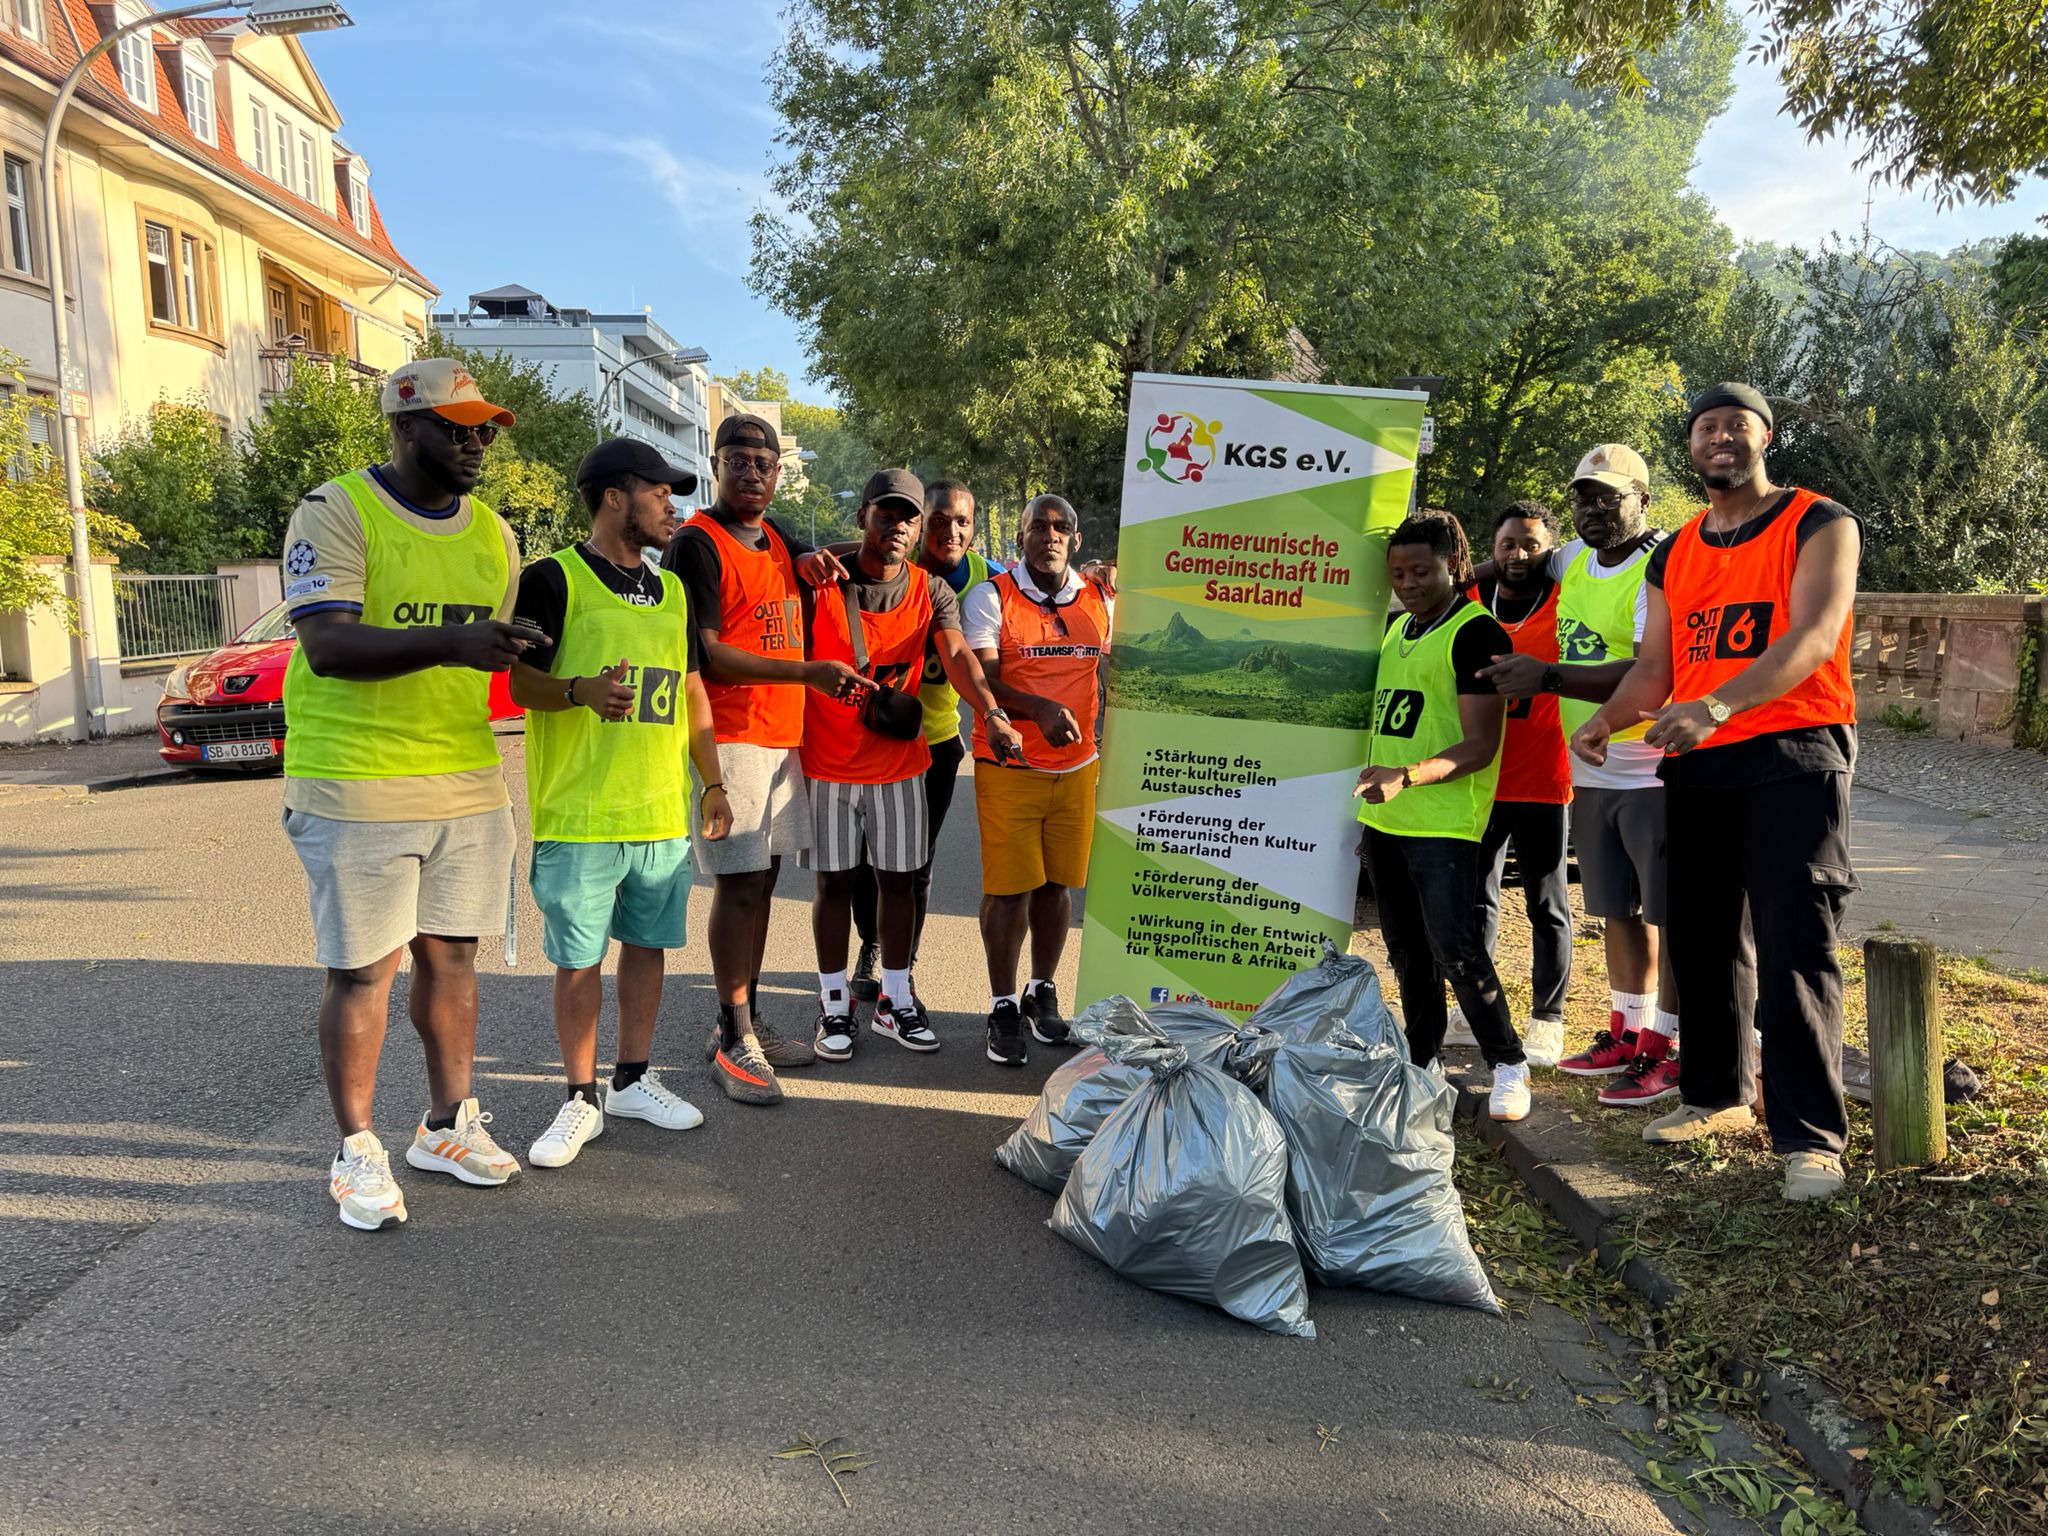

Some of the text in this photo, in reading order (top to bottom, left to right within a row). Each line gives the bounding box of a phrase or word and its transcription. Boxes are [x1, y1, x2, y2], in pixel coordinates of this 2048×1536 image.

[1224, 443, 1350, 473] KGS e.V.
[1182, 524, 1340, 558] Kamerunische
[1165, 550, 1350, 586] Gemeinschaft im
[312, 580, 326, 588] 10
[1204, 578, 1304, 608] Saarland
[394, 602, 437, 624] OUT
[754, 601, 780, 620] OUT
[1687, 606, 1721, 629] OUT
[765, 617, 783, 634] FIT
[1696, 624, 1717, 646] FIT
[760, 634, 785, 651] TER
[1688, 644, 1711, 664] TER
[209, 746, 224, 759] SB
[241, 743, 271, 757] 8105
[1155, 749, 1262, 770] Stärkung des
[1143, 763, 1277, 787] inter-kulturellen
[1141, 778, 1242, 799] Austausches
[1148, 810, 1266, 832] Förderung der
[1136, 838, 1232, 859] im Saarland
[1137, 823, 1317, 853] kamerunischen Kultur
[1142, 869, 1259, 892] Förderung der
[1131, 884, 1301, 914] Völkerverständigung
[1138, 914, 1334, 945] Wirkung in der Entwick-
[1127, 927, 1316, 959] lungspolitischen Arbeit
[1126, 942, 1298, 971] für Kamerun & Afrika
